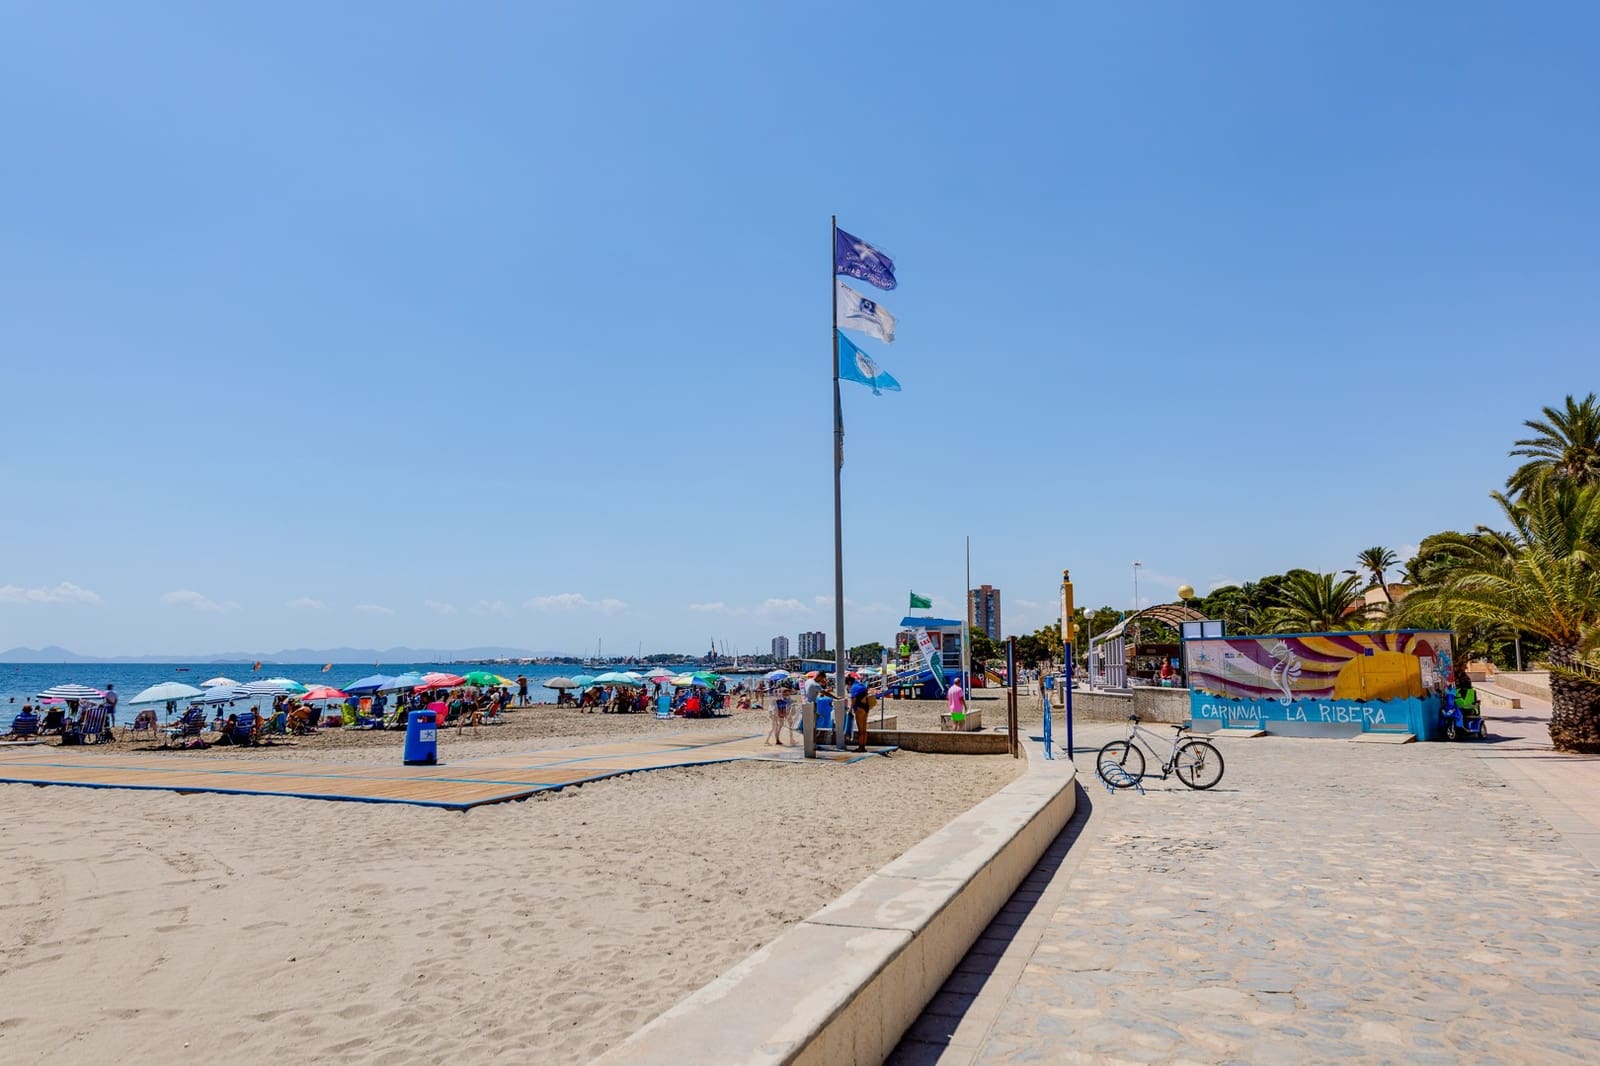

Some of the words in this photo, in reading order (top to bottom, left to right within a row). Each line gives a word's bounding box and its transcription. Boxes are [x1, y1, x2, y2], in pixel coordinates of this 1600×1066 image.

[1201, 704, 1269, 720] CARNAVAL
[1286, 707, 1308, 722] LA
[1319, 703, 1387, 725] RIBERA
